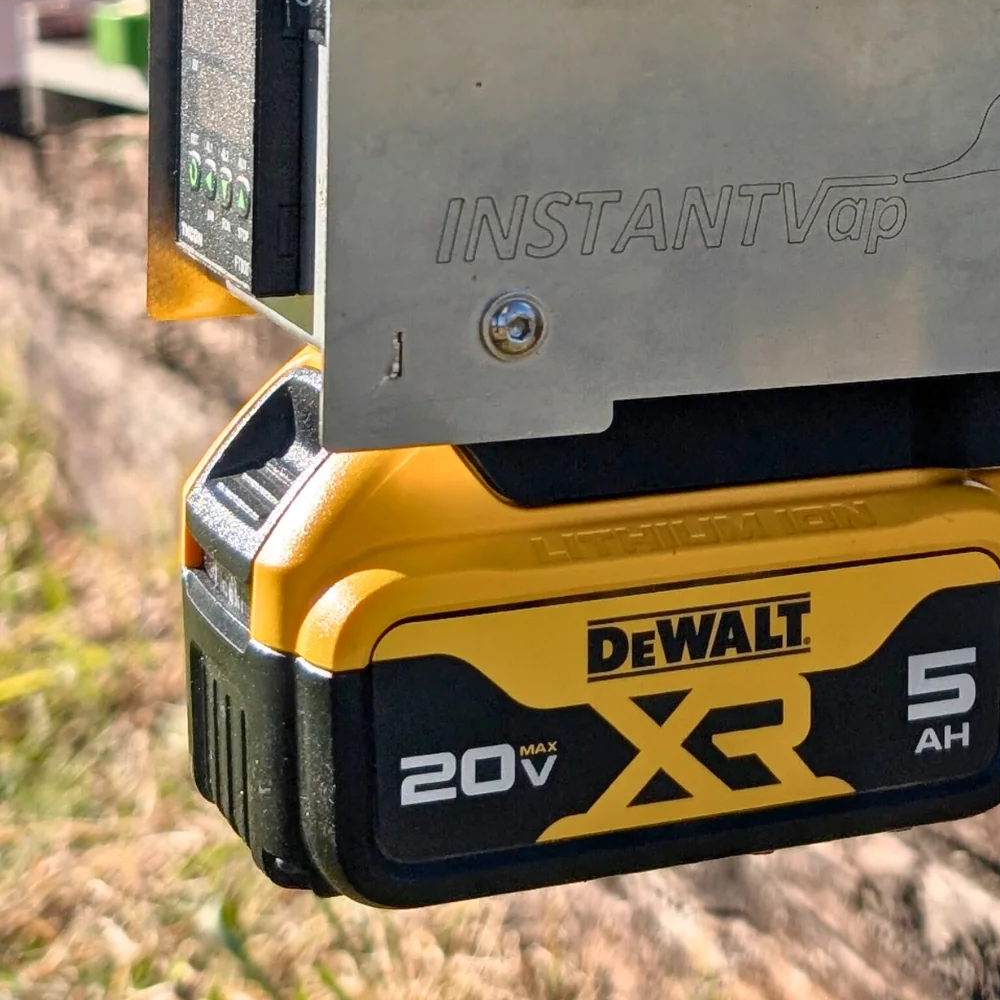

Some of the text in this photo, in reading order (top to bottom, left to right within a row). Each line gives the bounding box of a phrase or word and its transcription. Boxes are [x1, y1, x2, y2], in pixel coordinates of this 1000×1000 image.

[530, 500, 877, 564] LITHIUM ION
[907, 647, 977, 721] 5
[519, 741, 558, 757] MAX
[586, 678, 840, 826] XR
[914, 721, 970, 755] AH
